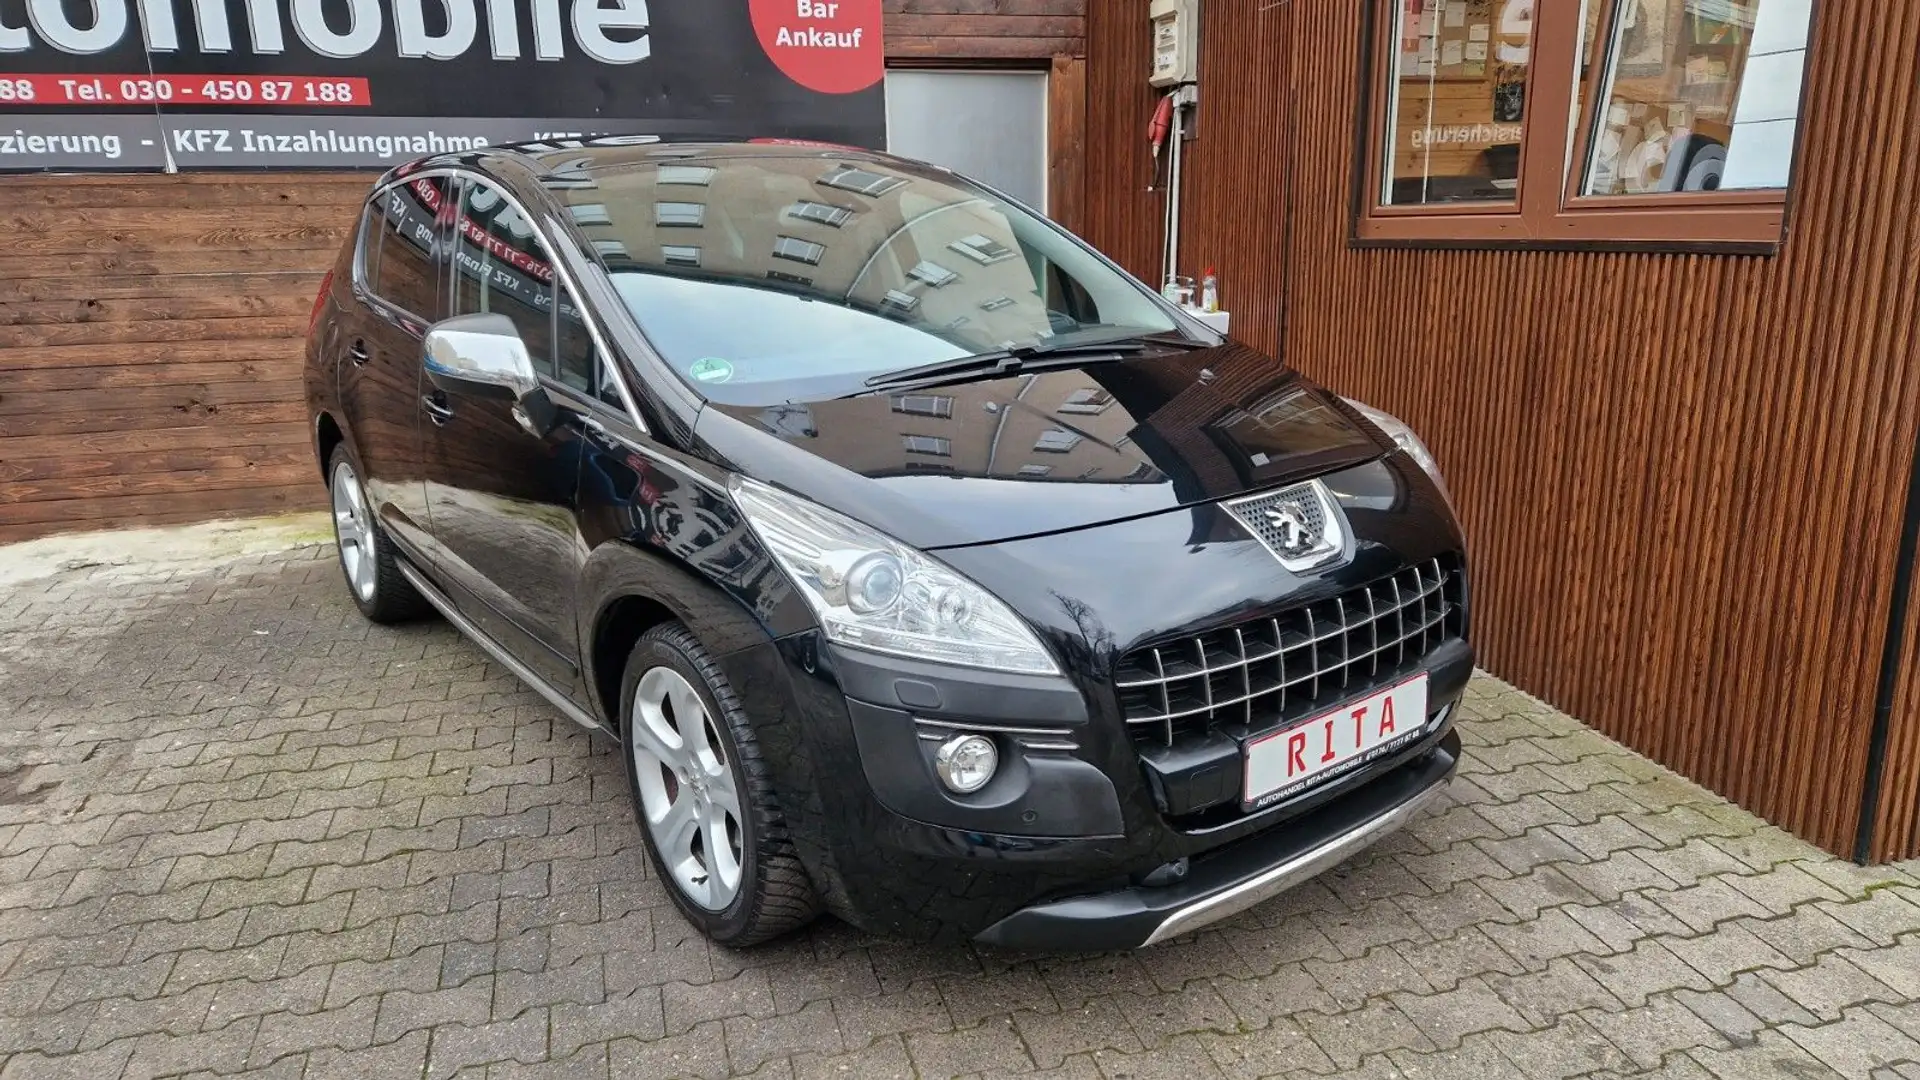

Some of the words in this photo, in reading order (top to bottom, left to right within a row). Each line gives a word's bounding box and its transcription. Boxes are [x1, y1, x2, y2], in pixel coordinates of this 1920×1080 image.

[797, 0, 839, 18] Bar
[775, 26, 863, 48] Ankauf
[0, 79, 35, 101] 88
[58, 79, 113, 101] Tel.
[120, 80, 173, 101] 030
[201, 80, 253, 101] 450
[260, 81, 293, 101] 87
[304, 82, 353, 102] 188
[0, 129, 122, 159] zierung
[173, 129, 233, 152] KFZ
[240, 129, 489, 159] Inzahlungnahme
[1287, 695, 1396, 777] RITA
